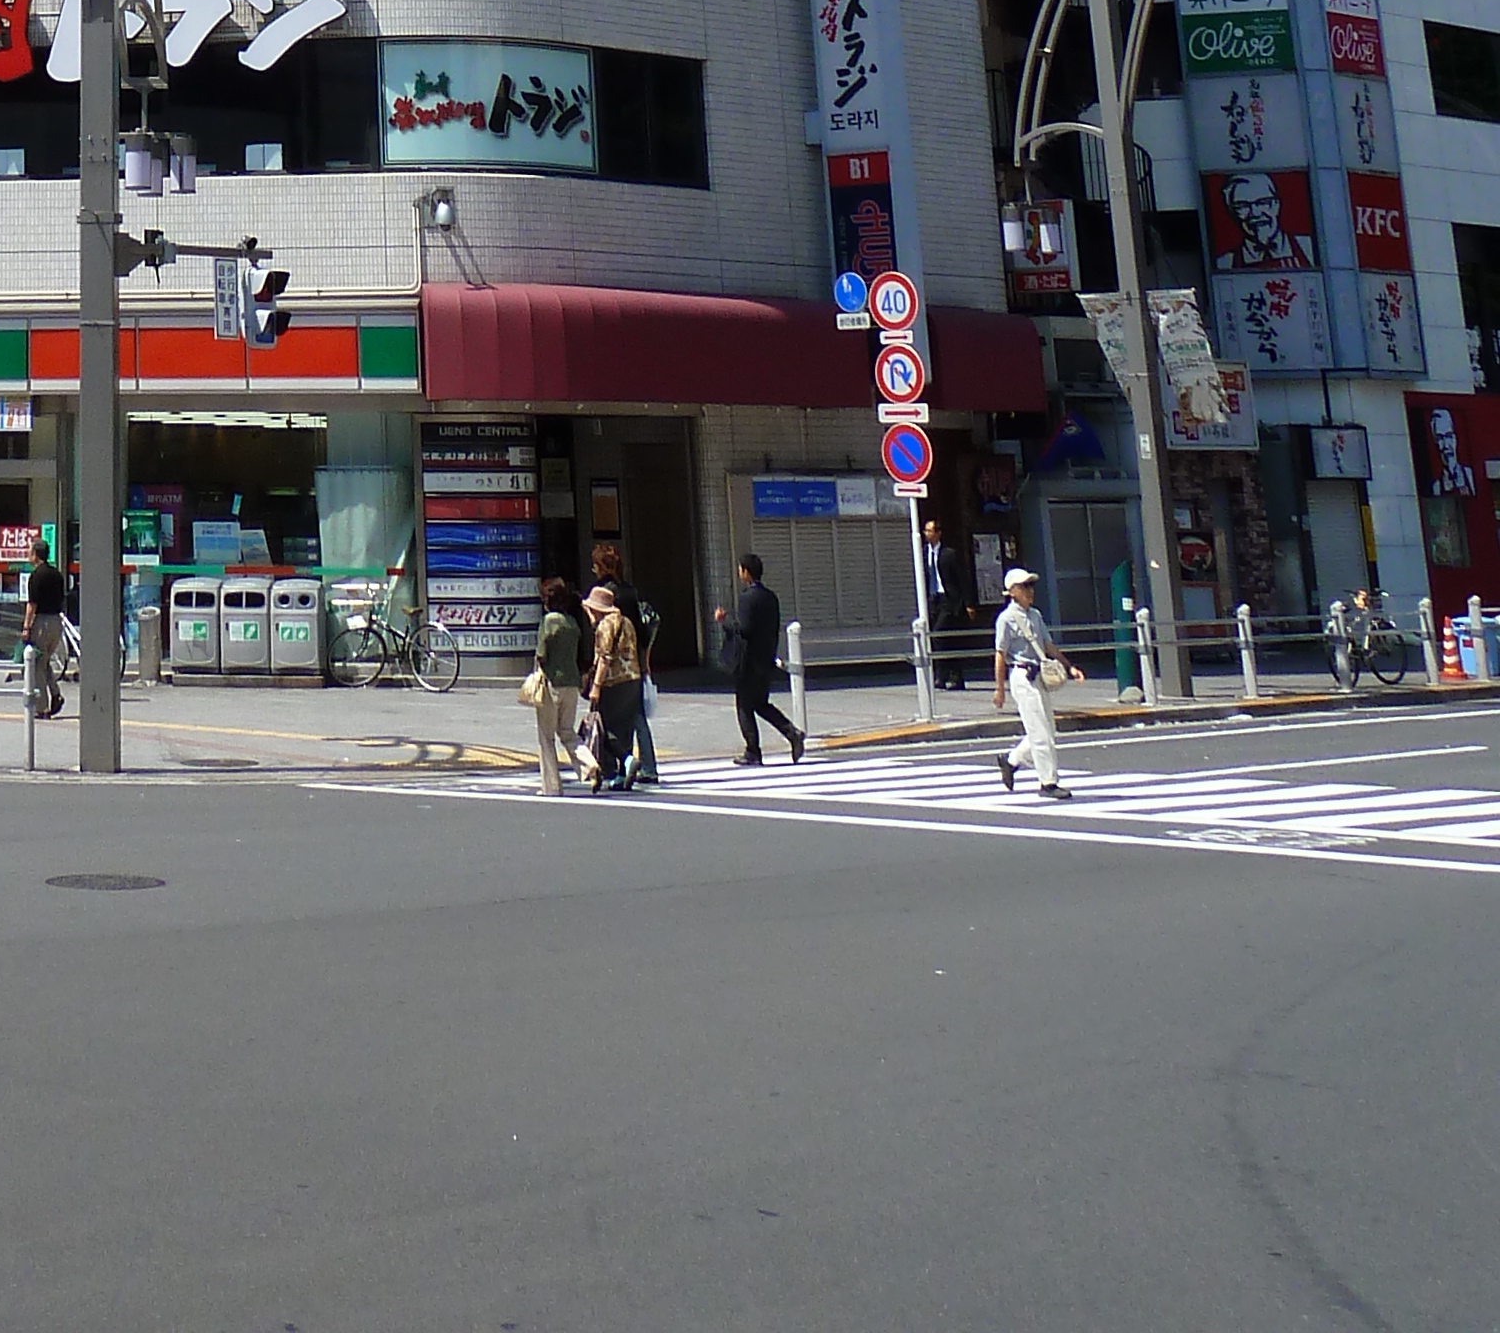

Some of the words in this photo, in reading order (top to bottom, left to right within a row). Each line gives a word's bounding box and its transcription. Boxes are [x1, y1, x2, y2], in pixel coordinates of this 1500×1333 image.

[1189, 21, 1276, 61] Olive
[1330, 22, 1376, 64] Olive
[488, 73, 591, 140] トラジ
[829, 107, 880, 132] 도라지
[849, 157, 871, 179] B1
[1355, 205, 1399, 239] KFC
[881, 290, 906, 315] 40
[438, 426, 472, 437] UENO
[1, 526, 40, 548] たばこ
[463, 631, 518, 647] ENGLISH
